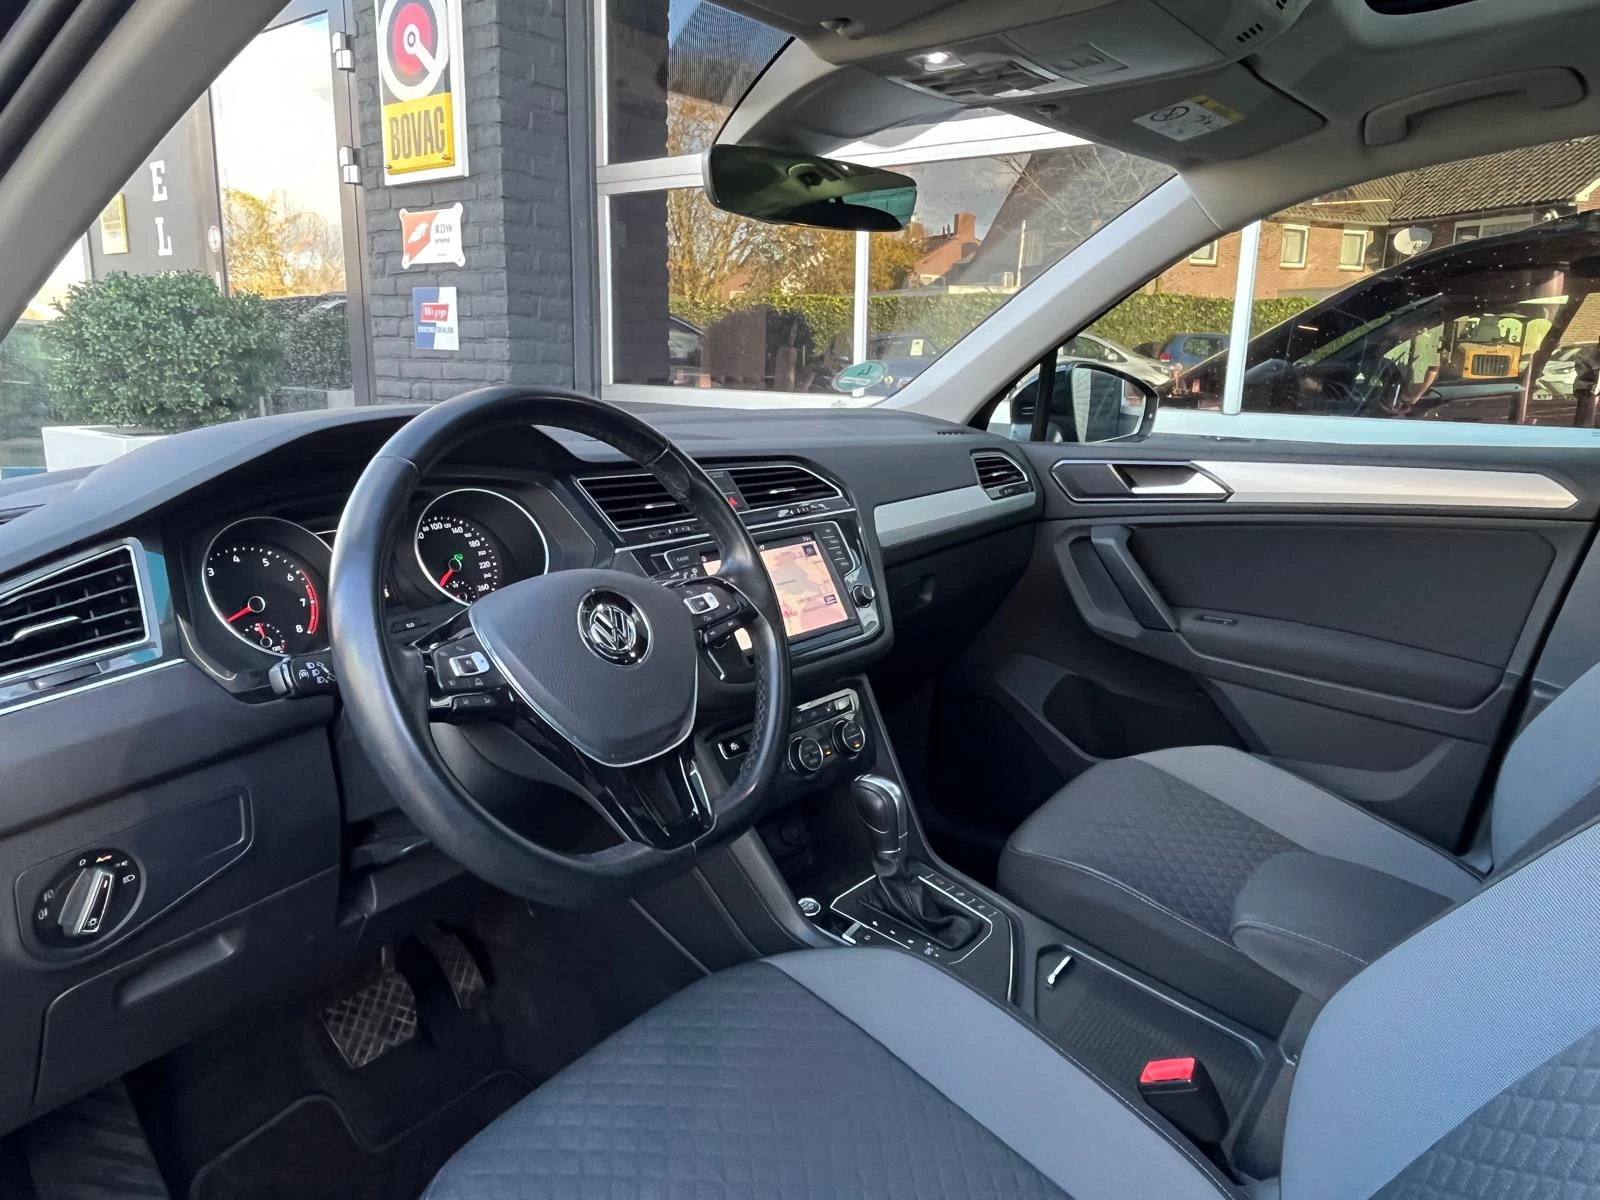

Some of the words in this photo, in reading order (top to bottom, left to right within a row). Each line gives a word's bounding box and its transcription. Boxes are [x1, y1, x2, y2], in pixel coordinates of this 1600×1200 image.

[390, 107, 445, 160] BOVAG
[430, 522, 442, 530] 100
[451, 526, 463, 534] 140
[233, 555, 240, 563] 4
[262, 558, 270, 567] 5
[479, 561, 491, 569] 220
[207, 567, 215, 577] 3
[287, 573, 294, 582] 6
[299, 598, 306, 607] 7
[295, 624, 303, 633] 8
